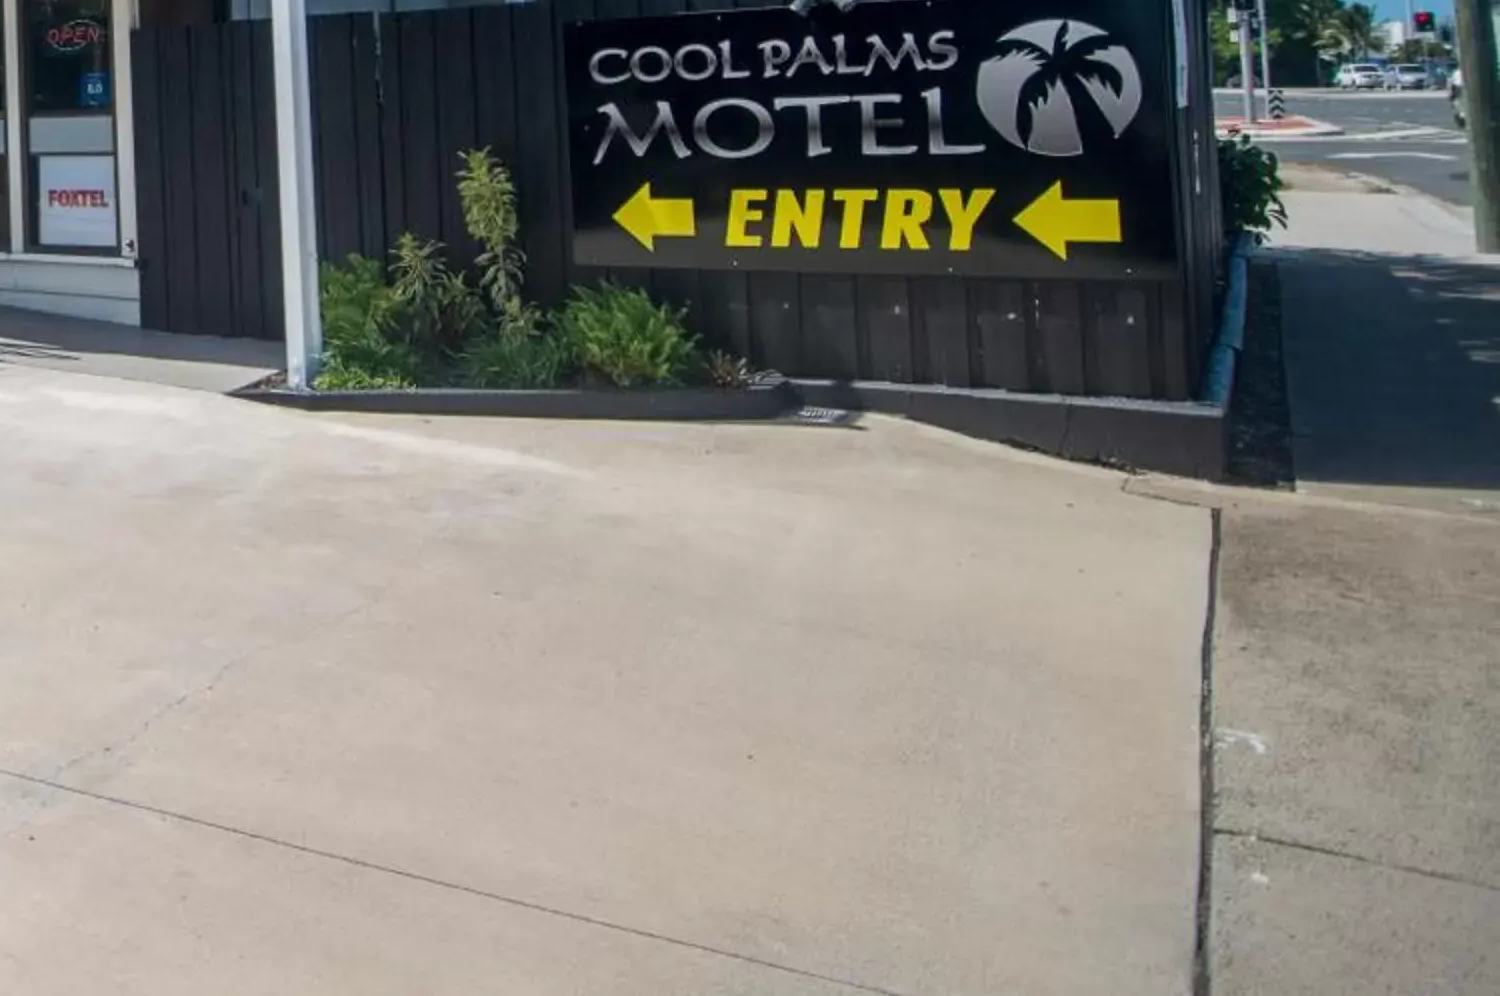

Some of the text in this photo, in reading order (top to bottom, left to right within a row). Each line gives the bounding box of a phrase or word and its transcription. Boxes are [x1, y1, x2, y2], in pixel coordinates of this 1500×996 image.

[47, 25, 100, 44] OPEN
[588, 29, 960, 84] COOL PALMS
[592, 86, 988, 166] MOTEL
[47, 188, 109, 209] FOXTEL
[724, 187, 997, 252] ENTRY
